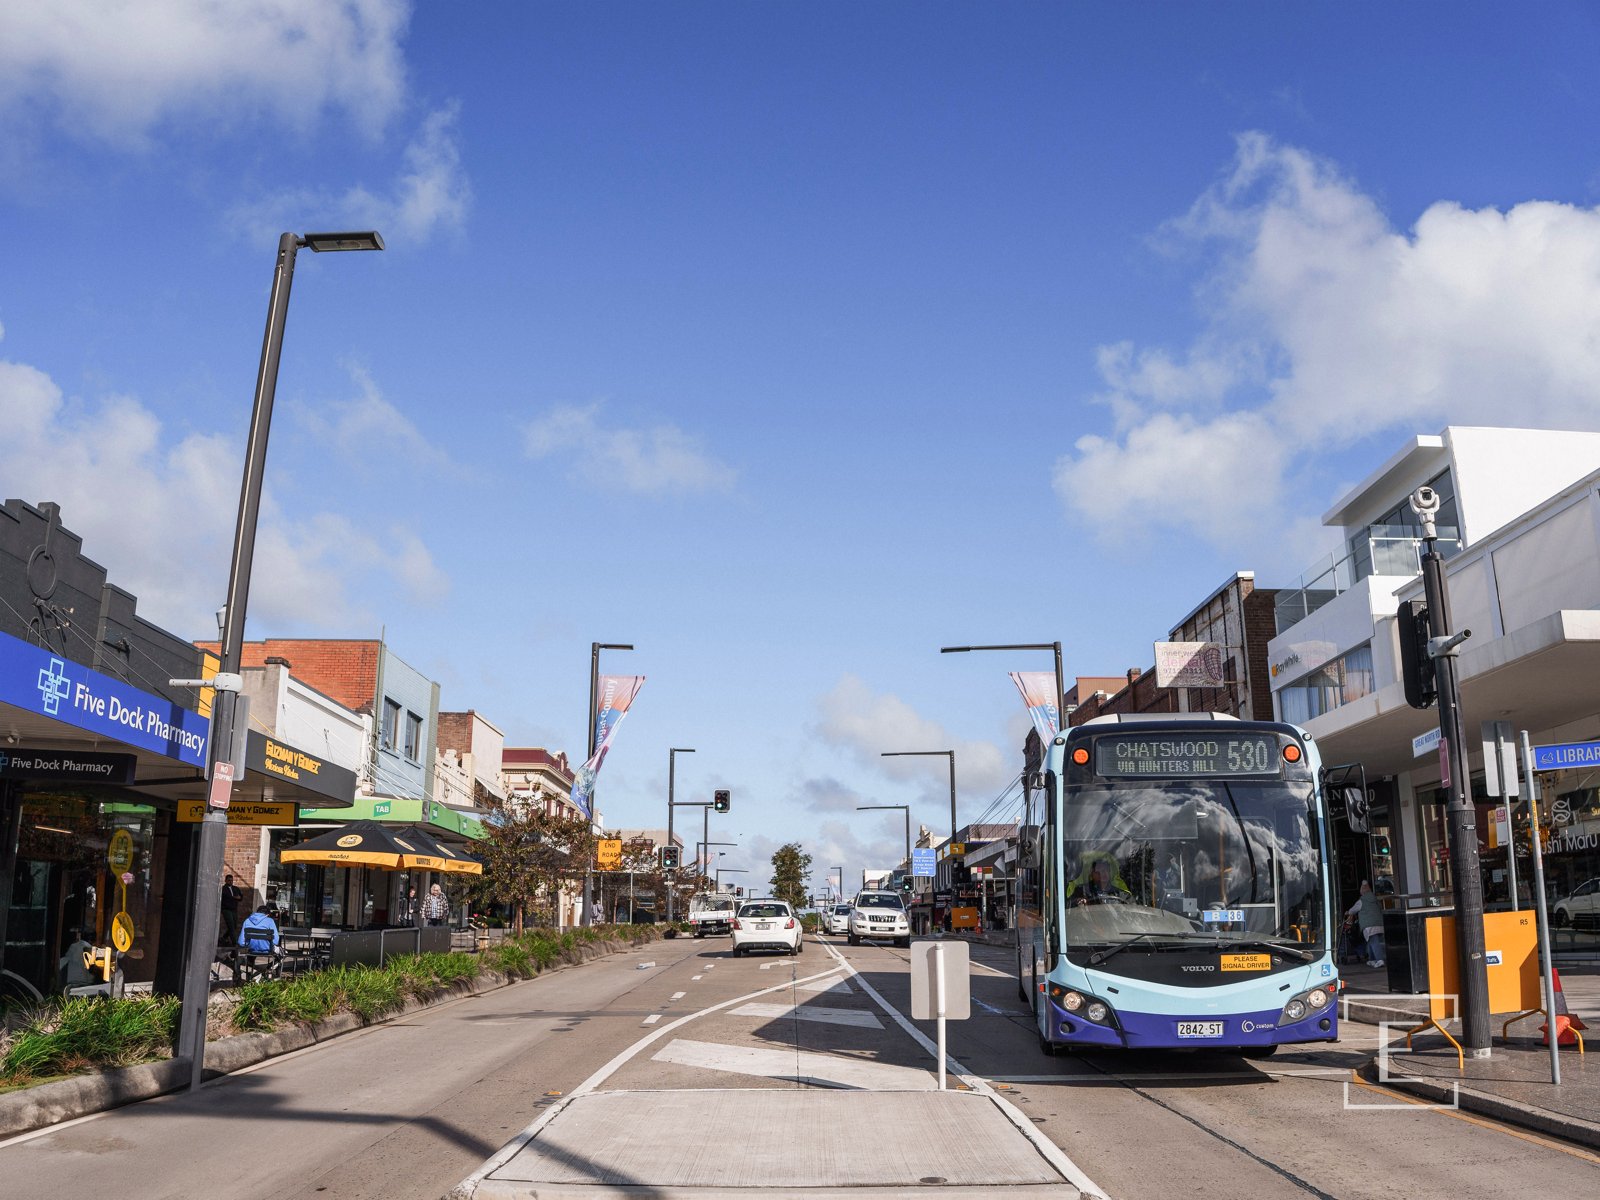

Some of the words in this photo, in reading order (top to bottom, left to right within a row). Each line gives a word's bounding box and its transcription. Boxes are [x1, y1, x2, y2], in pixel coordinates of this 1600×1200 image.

[600, 679, 618, 718] Country
[74, 682, 105, 717] Five
[108, 695, 144, 731] Dock
[146, 710, 206, 757] Pharmacy
[1424, 731, 1436, 744] NORTH
[265, 739, 294, 764] GUZMAN
[293, 752, 299, 766] Y
[1116, 741, 1219, 758] CHATSWOOD
[1227, 740, 1268, 771] 530
[11, 757, 32, 769] Five
[34, 758, 60, 770] Dock
[62, 759, 114, 775] Pharmacy
[1118, 760, 1135, 773] VIA
[1139, 760, 1190, 773] HUNTERS
[1192, 760, 1216, 772] HILL
[246, 806, 253, 814] Y
[376, 805, 390, 813] TAB
[1541, 833, 1562, 855] ushi
[1566, 829, 1598, 851] Maru
[1230, 910, 1242, 921] 36
